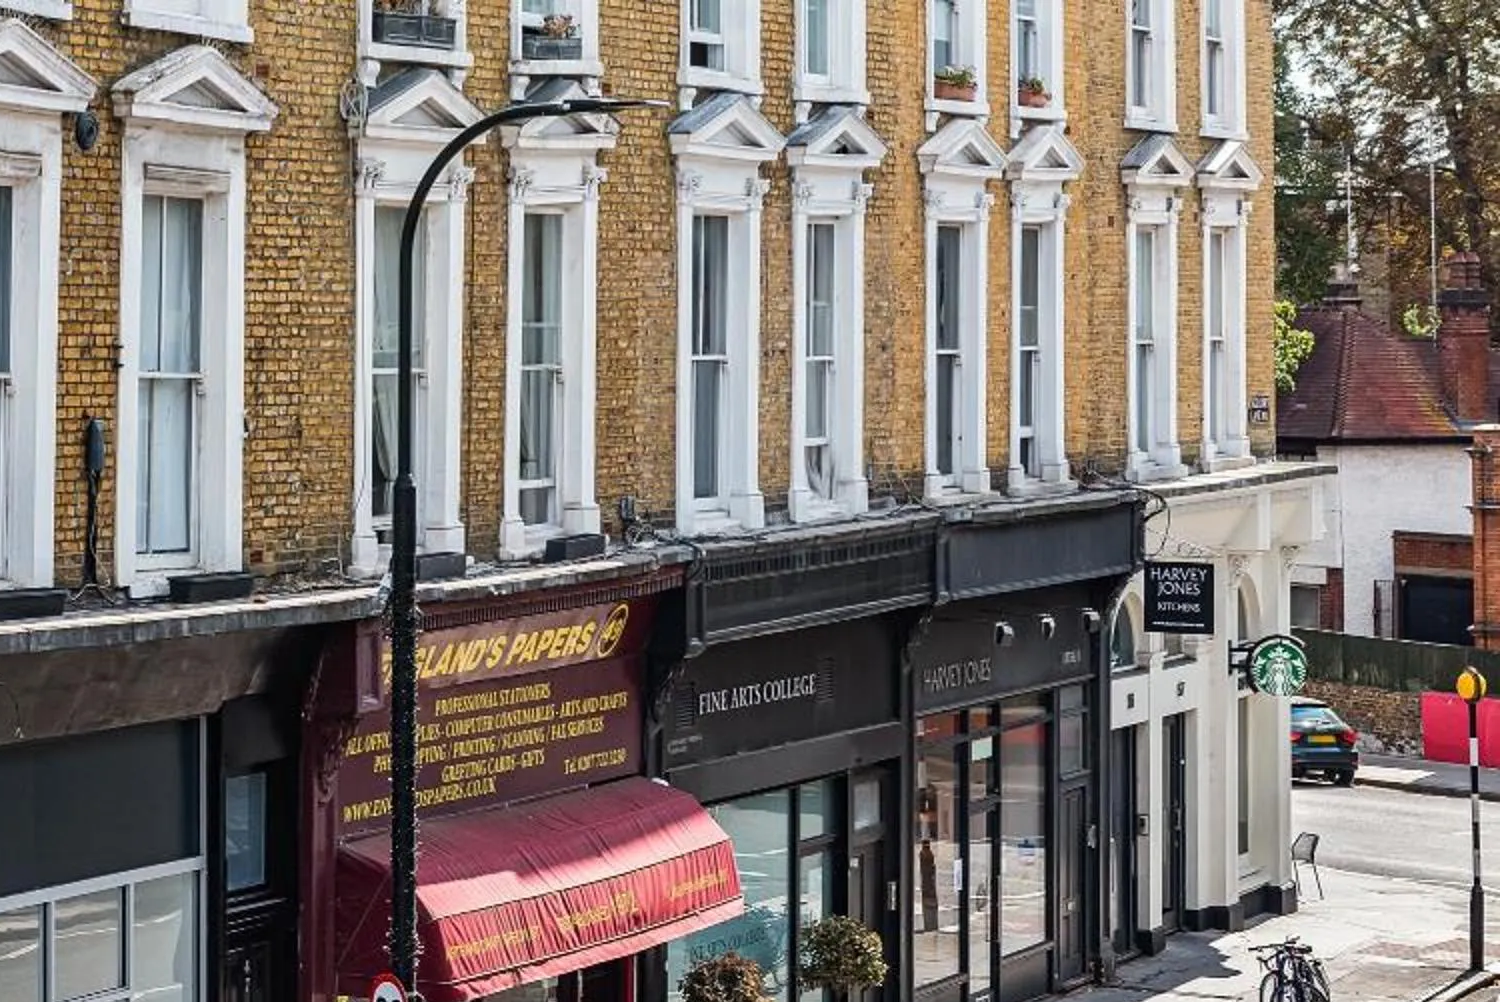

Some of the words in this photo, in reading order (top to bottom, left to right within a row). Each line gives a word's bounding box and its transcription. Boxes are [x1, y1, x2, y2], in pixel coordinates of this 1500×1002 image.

[1151, 567, 1208, 581] HARVEY
[1157, 582, 1201, 596] JONES
[1157, 601, 1201, 613] KITCHENS
[506, 622, 597, 665] PAPERS
[699, 689, 729, 715] FINE
[730, 683, 761, 709] ARTS
[763, 673, 817, 703] COLLEGE
